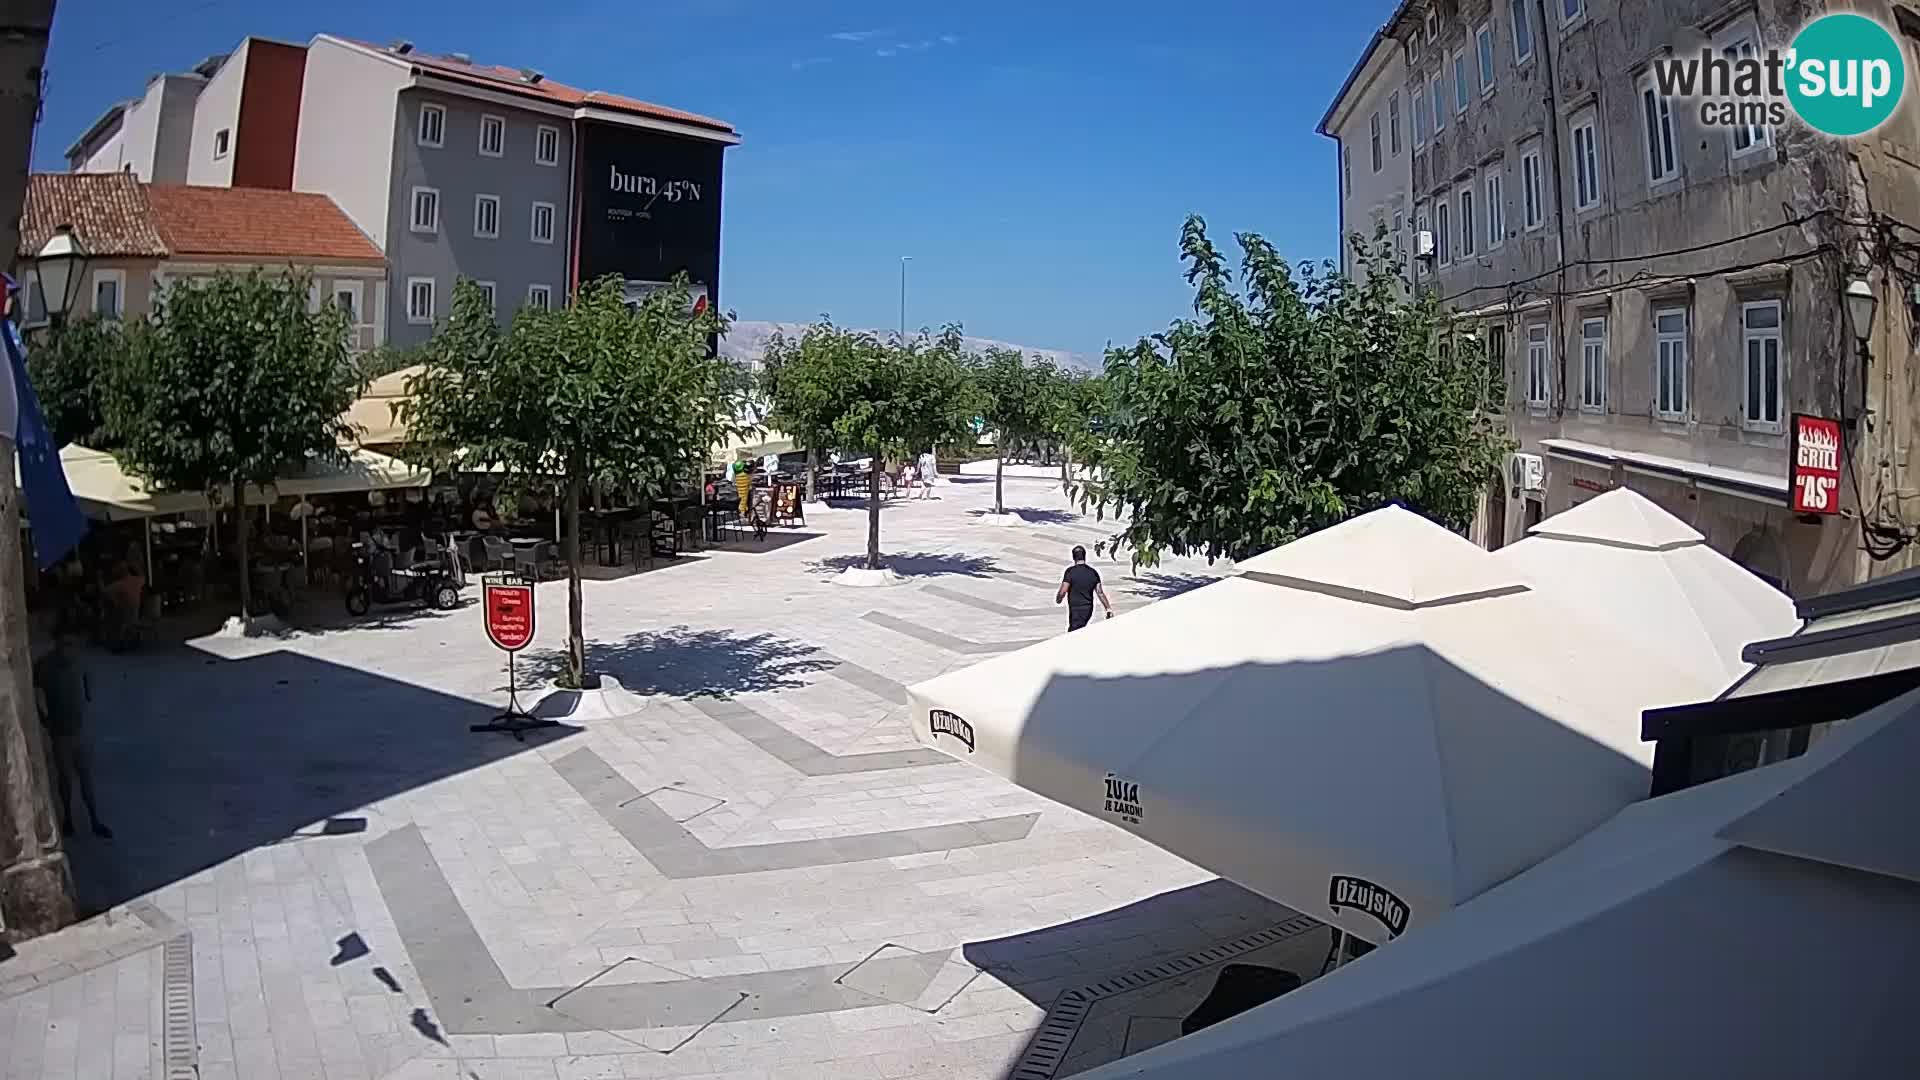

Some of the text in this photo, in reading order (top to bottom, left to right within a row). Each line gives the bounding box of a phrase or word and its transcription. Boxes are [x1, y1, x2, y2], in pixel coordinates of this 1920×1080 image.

[610, 164, 656, 195] bura
[1797, 446, 1838, 471] GRILL
[485, 577, 523, 585] WINE BAR
[1104, 800, 1113, 812] JE
[1336, 879, 1403, 929] Ožujsko
